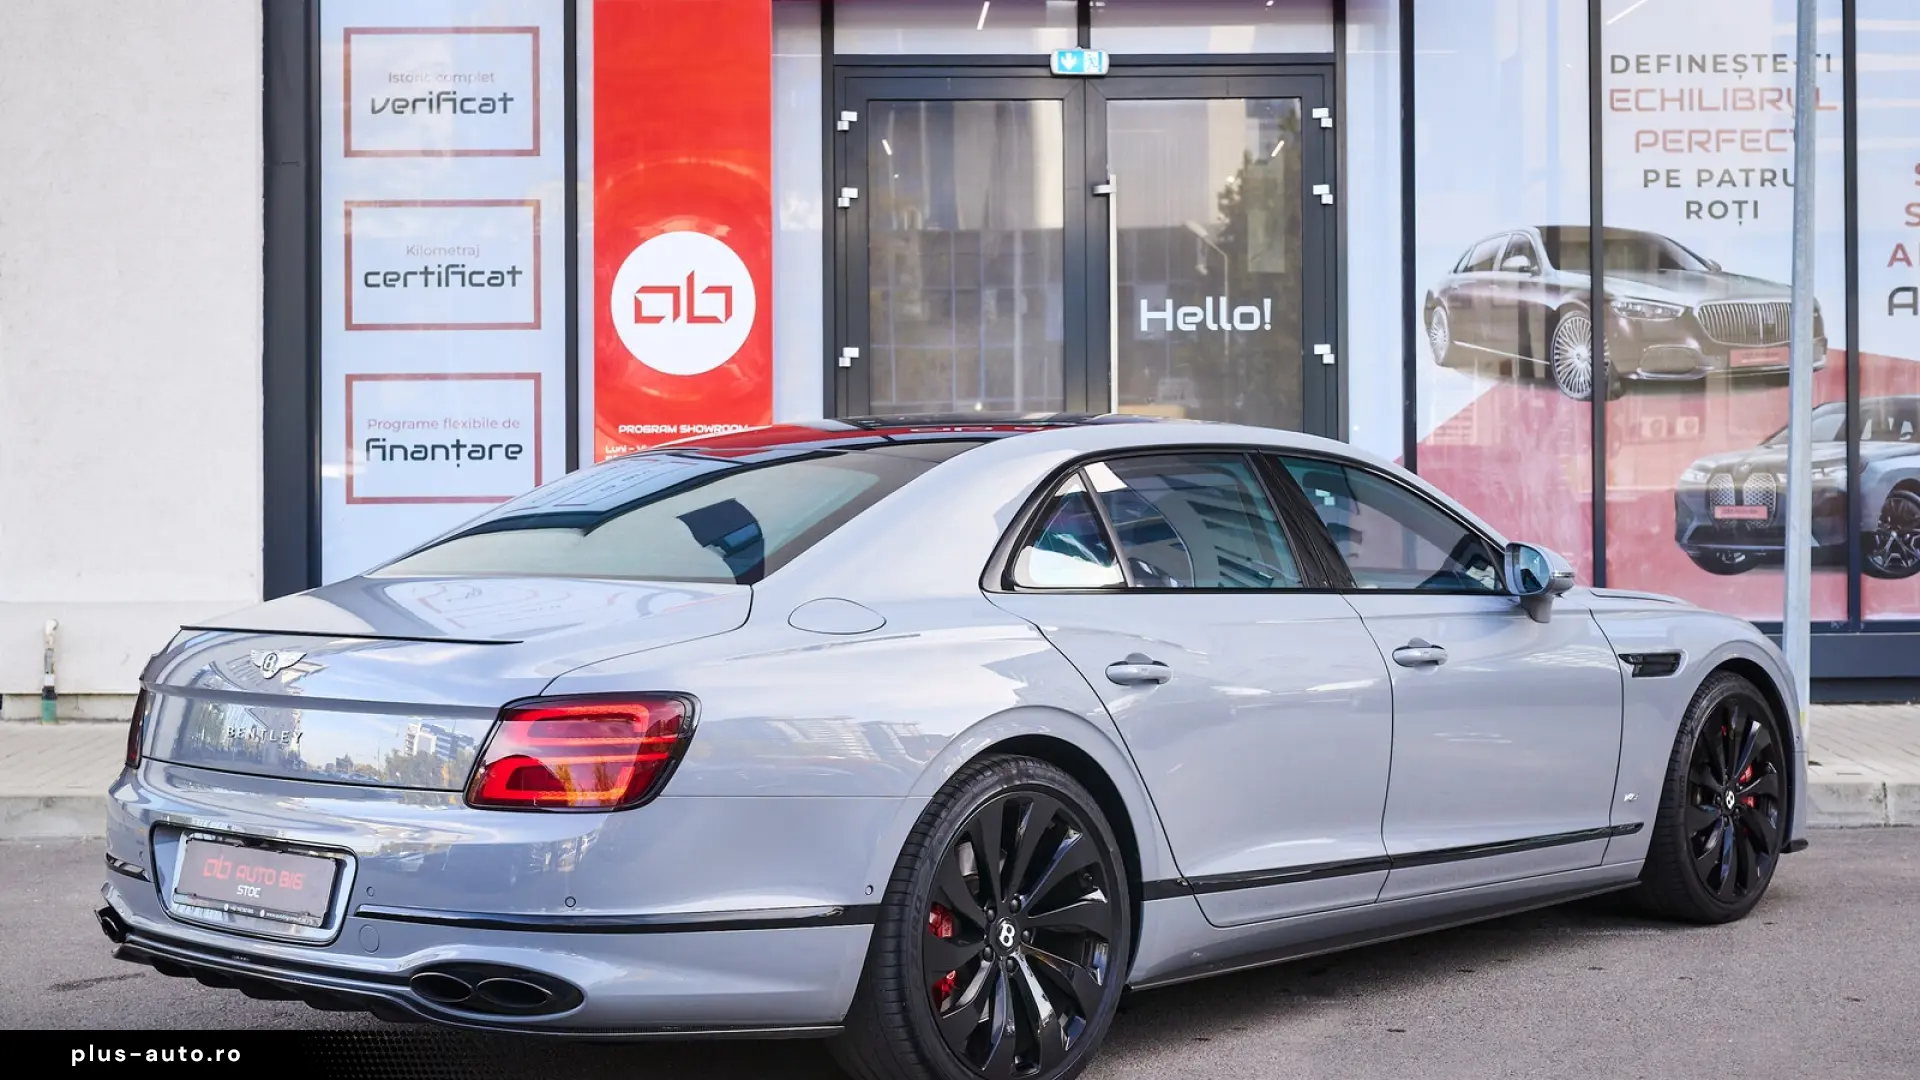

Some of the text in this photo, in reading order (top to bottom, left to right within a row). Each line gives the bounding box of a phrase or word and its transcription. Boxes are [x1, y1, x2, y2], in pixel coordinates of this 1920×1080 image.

[1610, 53, 1831, 80] DEFINEȘTEI
[389, 72, 495, 85] Istoric complet
[371, 91, 514, 115] verificat
[1635, 128, 1796, 153] PERFEC
[1643, 169, 1682, 188] PE
[1686, 200, 1759, 226] ROȚI
[406, 245, 480, 259] Kilometraj
[364, 264, 523, 288] certificat
[1140, 296, 1272, 331] Hello!
[367, 417, 521, 432] Programe flexibile de
[618, 424, 677, 434] PROGRAM
[366, 437, 523, 468] finanțare
[228, 726, 303, 744] BENTLEY
[236, 865, 276, 885] AUTO
[236, 884, 262, 898] STOC
